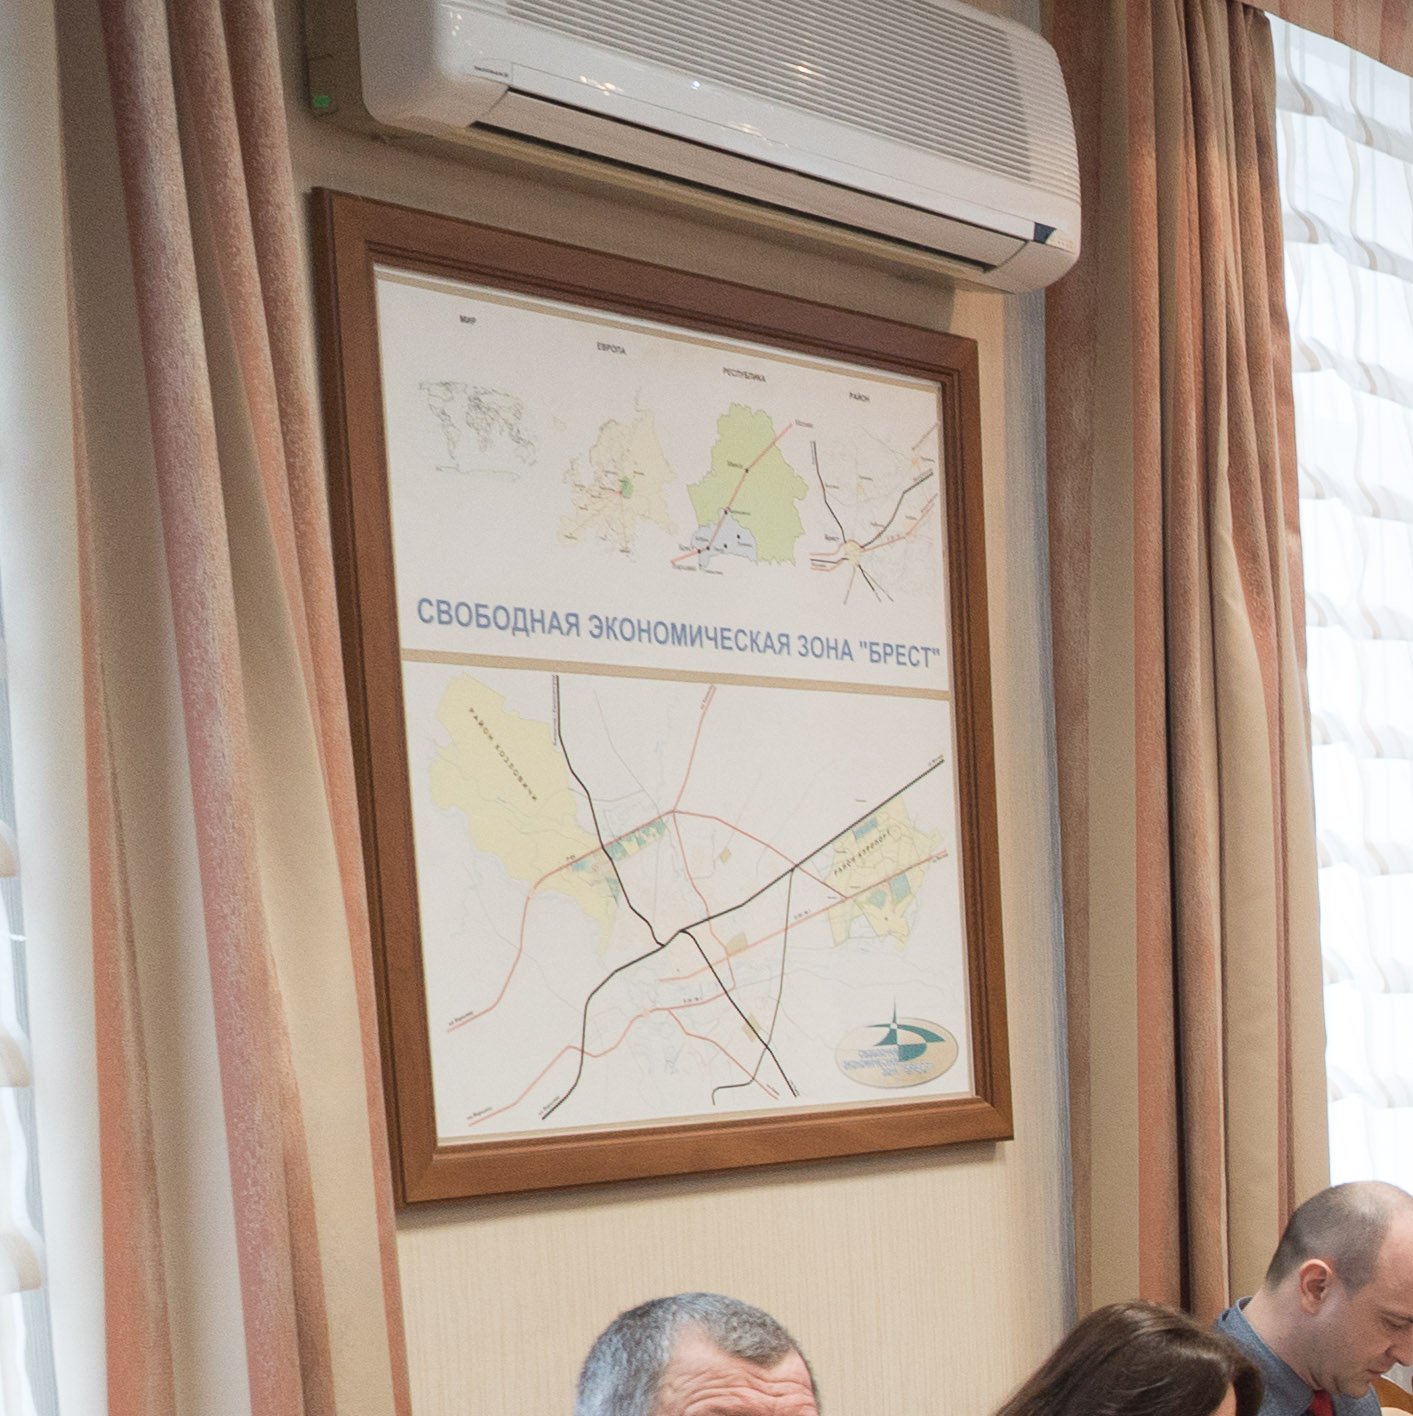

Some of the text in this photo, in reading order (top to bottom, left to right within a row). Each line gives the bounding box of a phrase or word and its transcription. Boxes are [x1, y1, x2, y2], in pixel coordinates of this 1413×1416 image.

[416, 597, 941, 669] СВОБОДНАЯ ЭКОНОМИЧЕСКАЯ ЗОНА "БРЕСТ"
